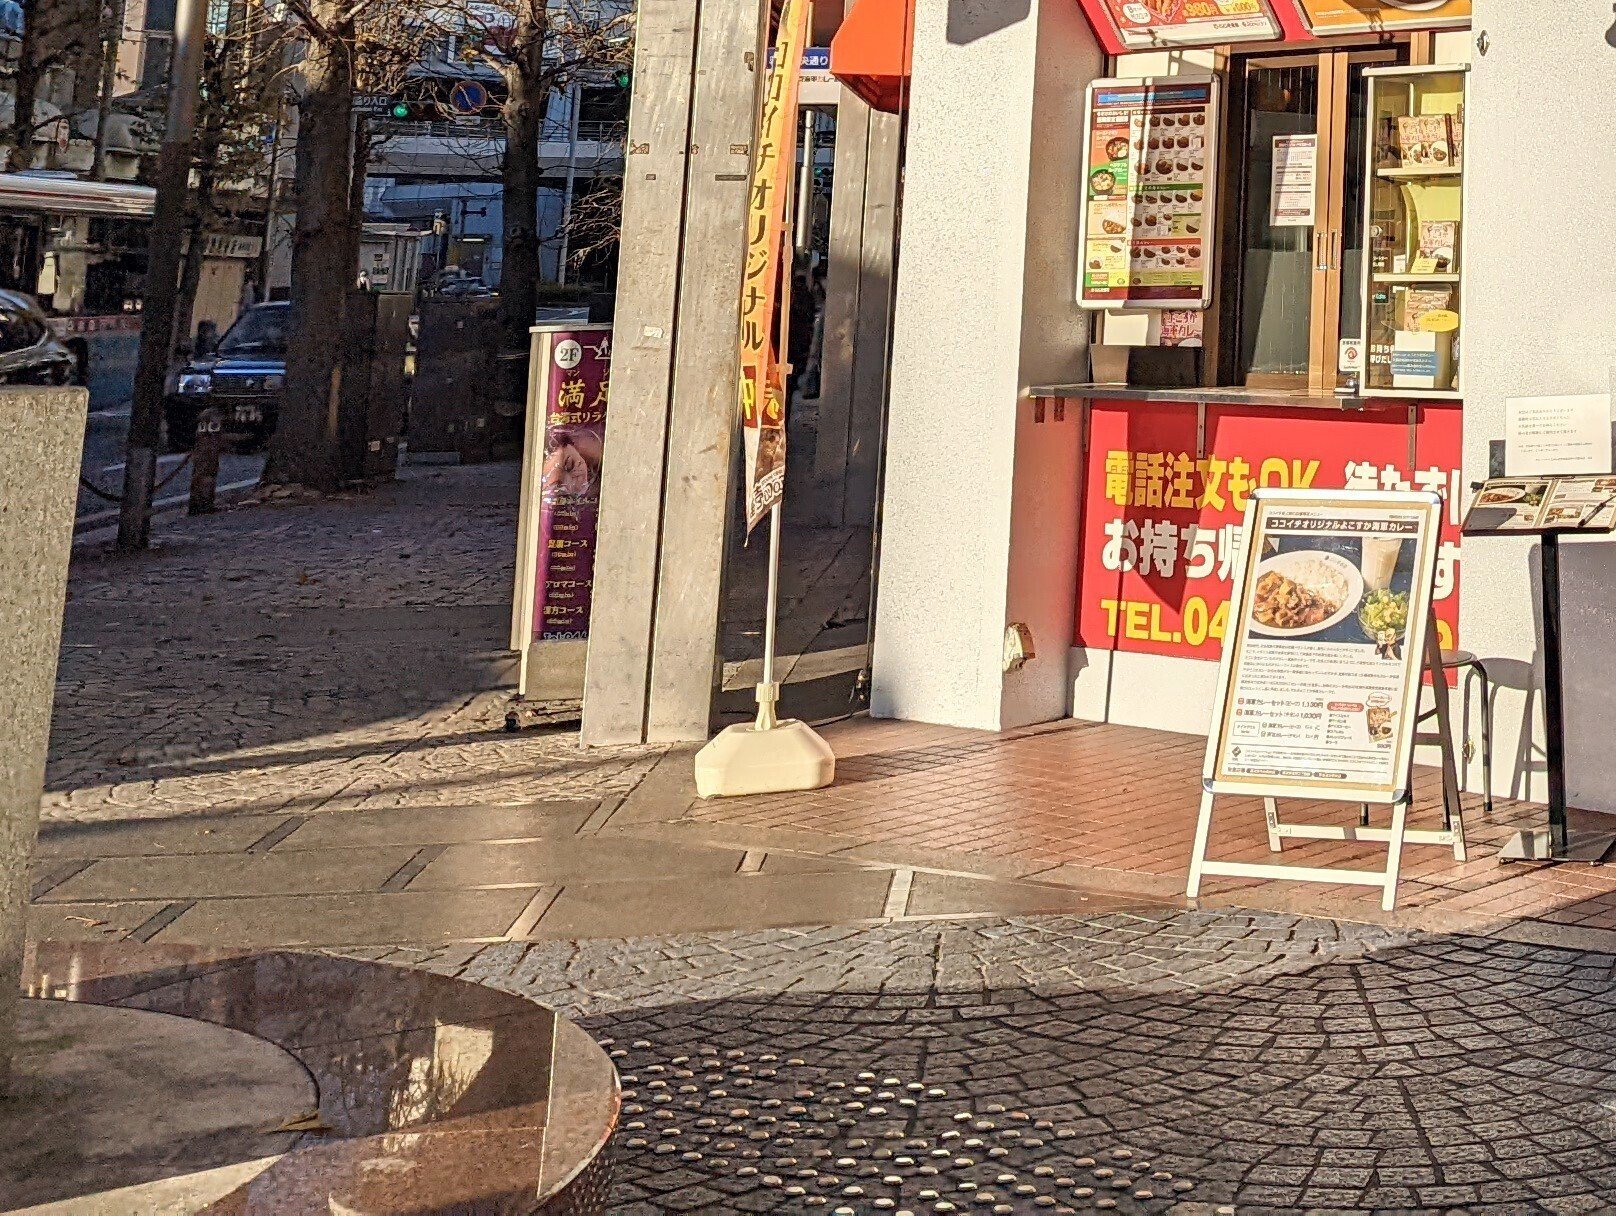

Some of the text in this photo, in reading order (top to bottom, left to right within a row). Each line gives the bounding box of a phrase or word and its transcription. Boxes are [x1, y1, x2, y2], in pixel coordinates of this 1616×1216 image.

[559, 347, 580, 362] 2F
[1270, 519, 1414, 532] ココイチオリジナルよこすか海軍カレー
